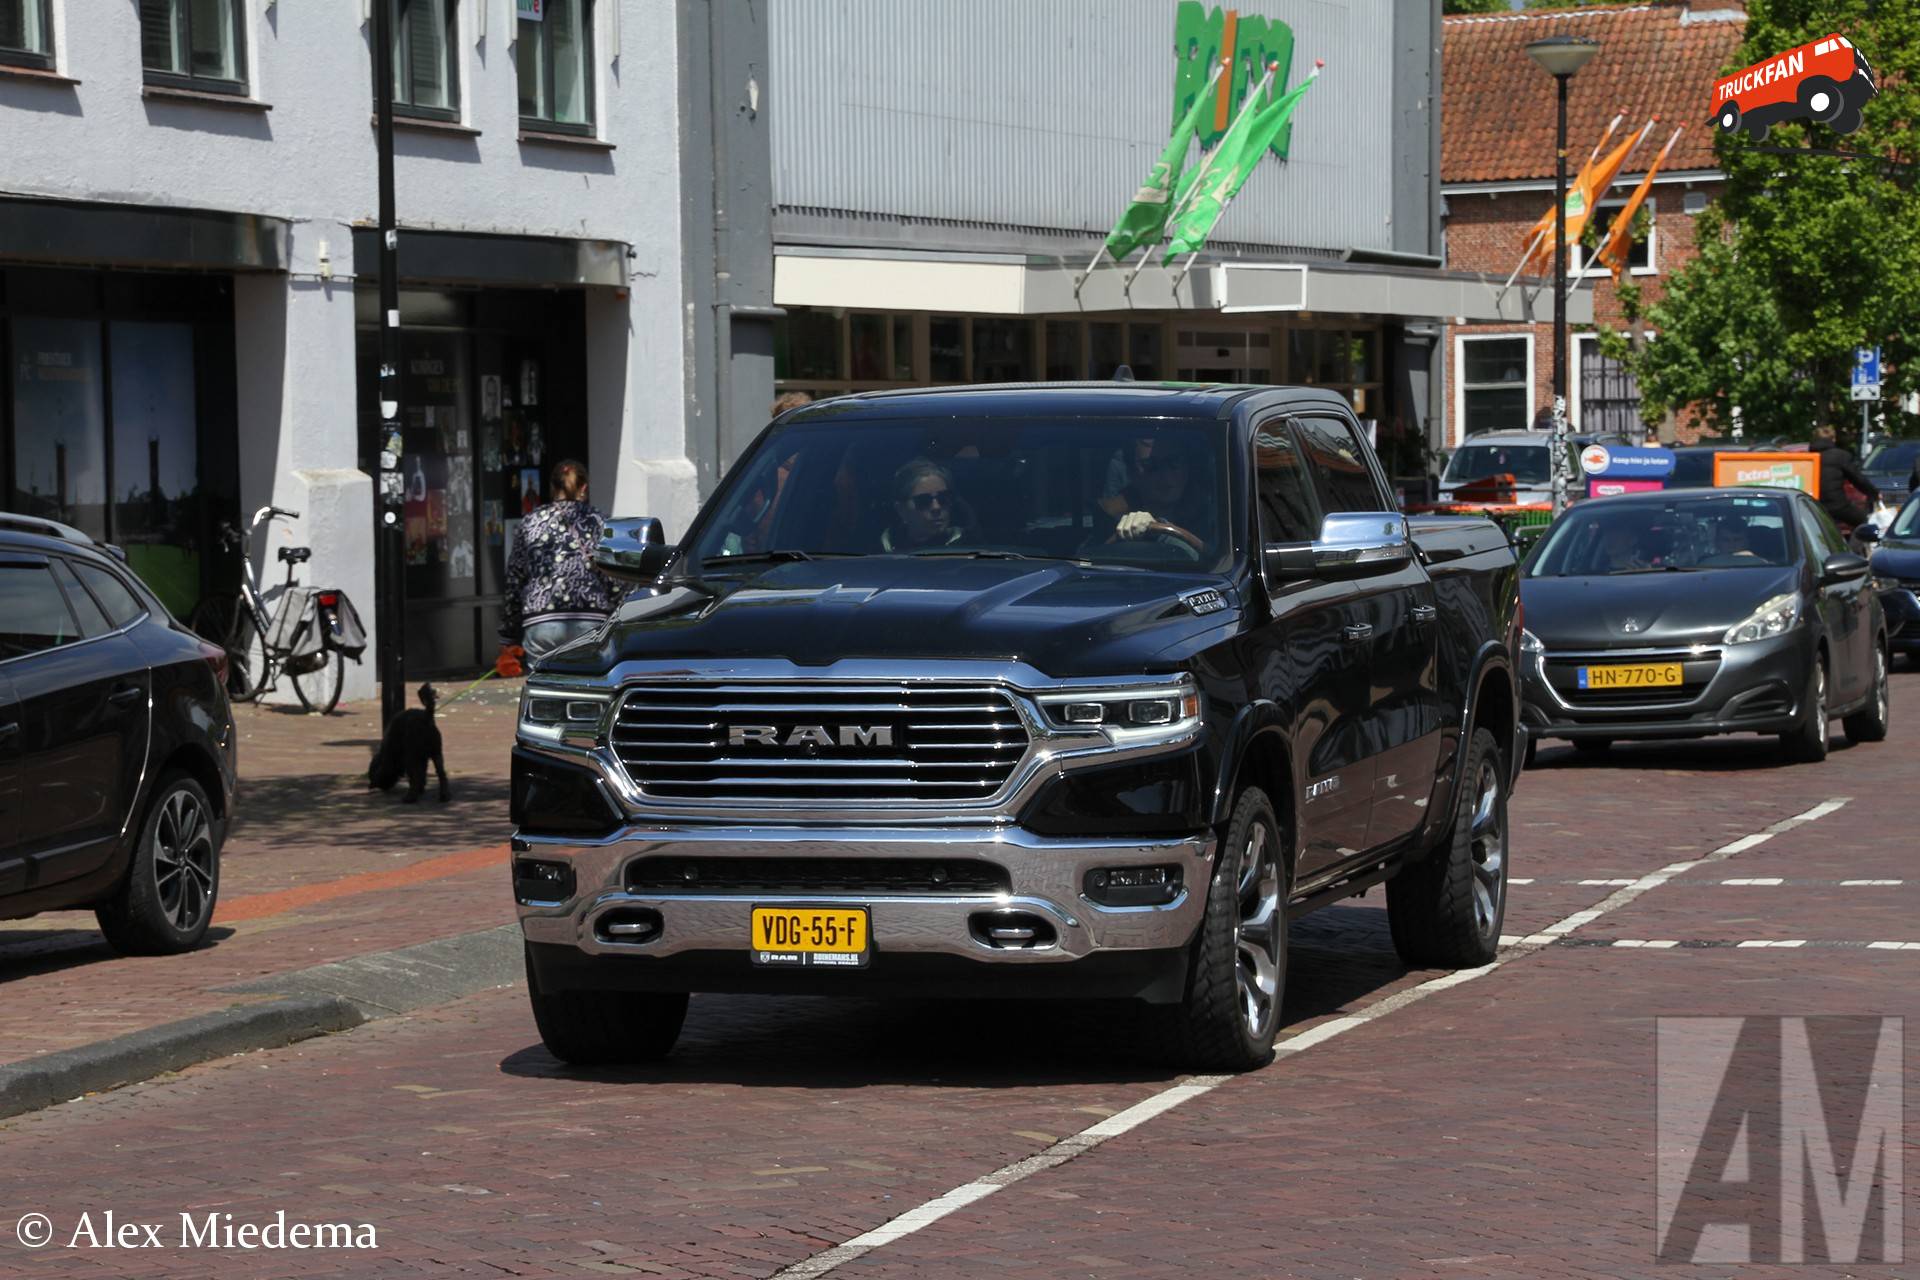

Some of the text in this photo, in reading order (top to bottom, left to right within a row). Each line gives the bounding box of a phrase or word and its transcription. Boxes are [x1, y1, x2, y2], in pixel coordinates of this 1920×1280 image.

[1737, 469, 1771, 482] Extra
[1592, 667, 1676, 685] HN-770-G
[728, 725, 893, 746] RAM
[762, 915, 857, 946] VDG-55-F
[770, 953, 798, 961] RAM
